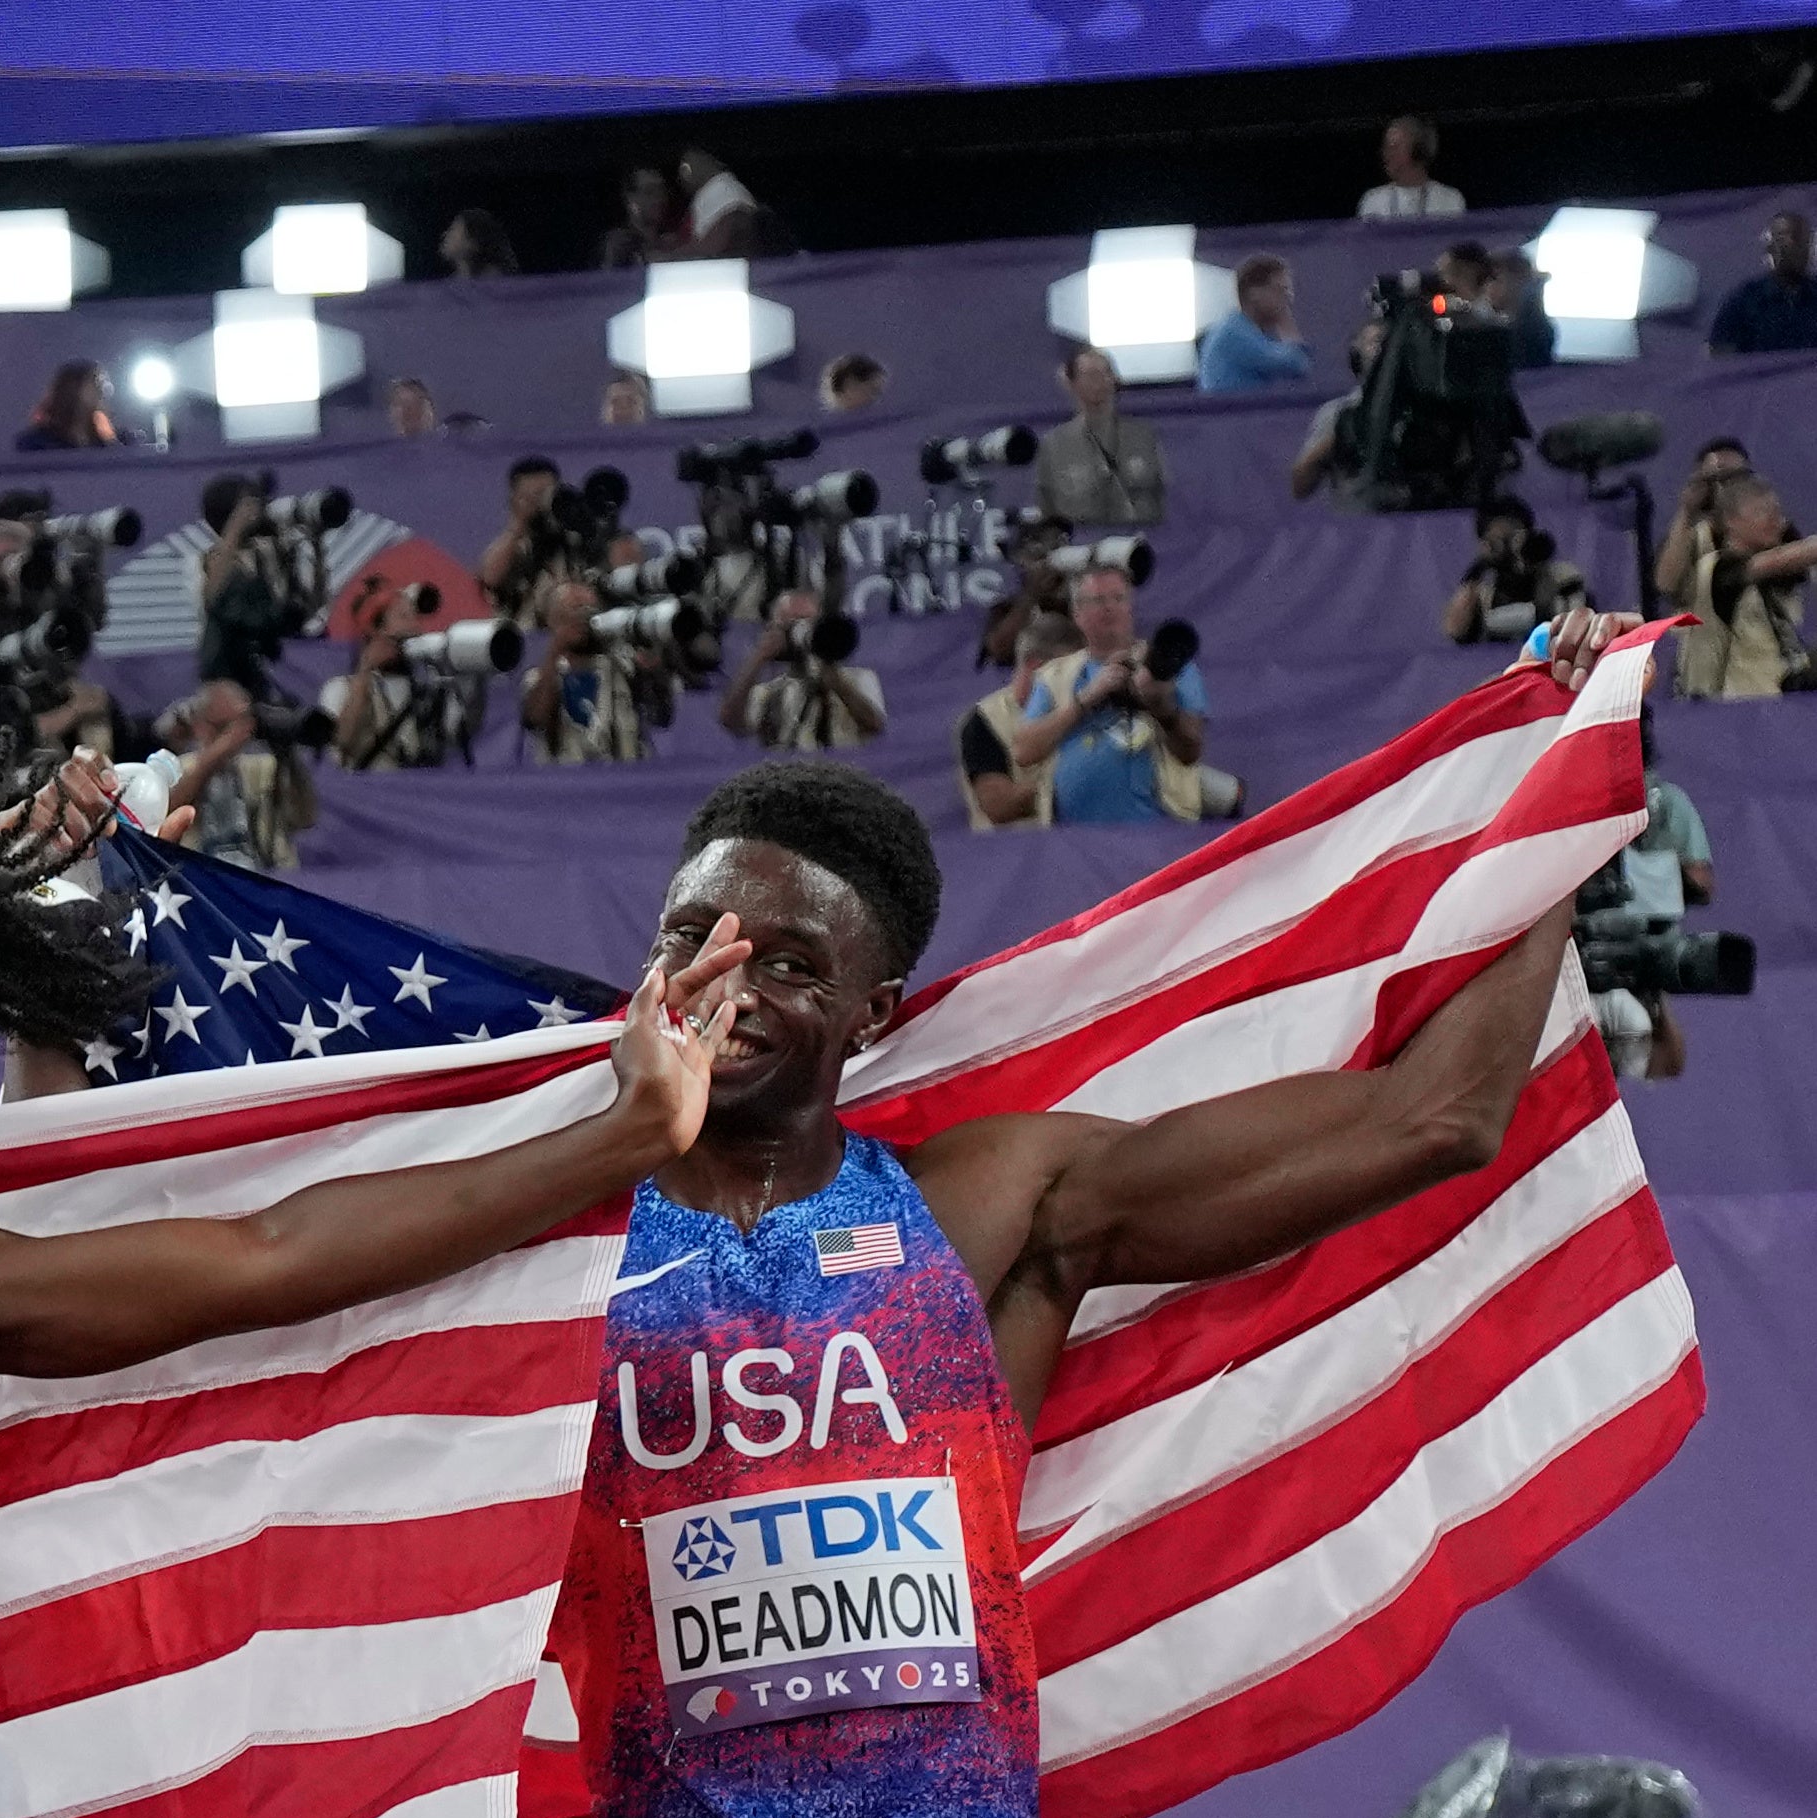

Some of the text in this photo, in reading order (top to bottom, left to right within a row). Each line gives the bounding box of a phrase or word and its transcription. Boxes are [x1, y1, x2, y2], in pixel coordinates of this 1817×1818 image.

[617, 1331, 908, 1470] USA
[730, 1489, 944, 1567] TDK
[671, 1572, 962, 1672] DEADMON
[750, 1660, 970, 1707] TOKYO 25
